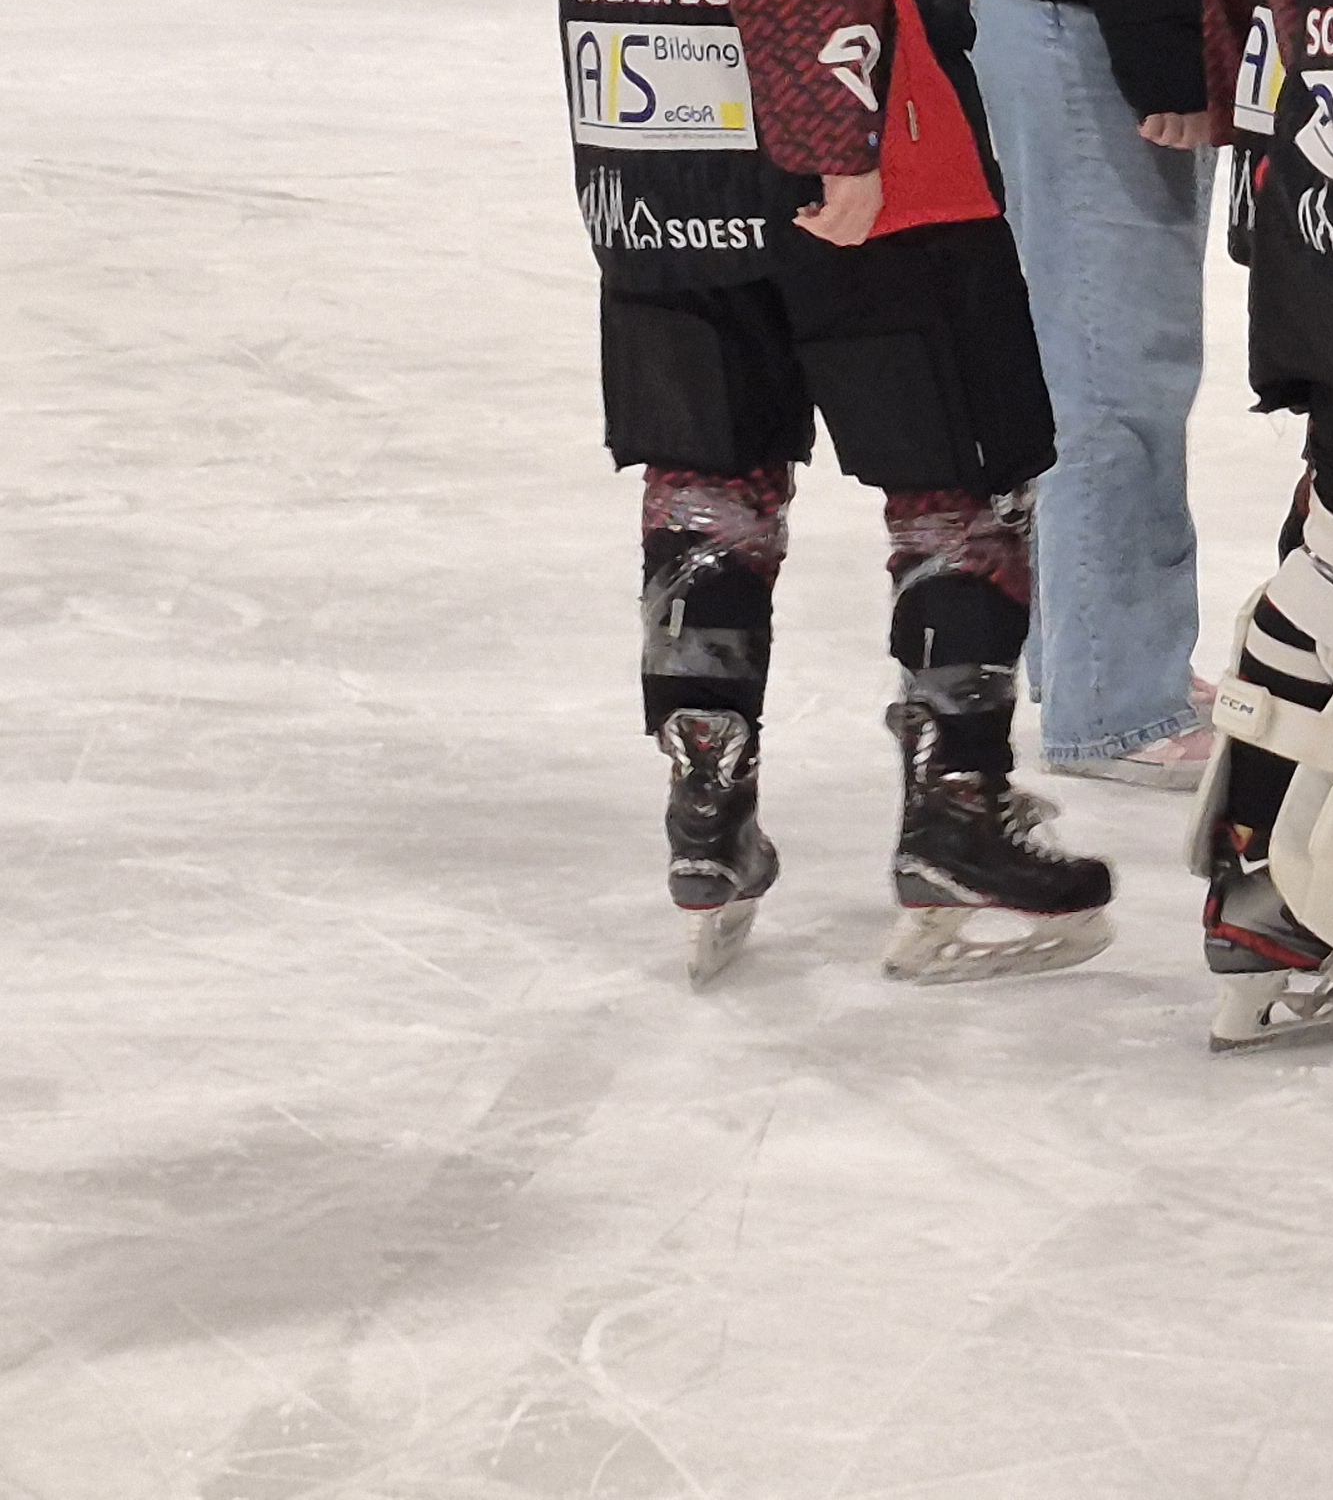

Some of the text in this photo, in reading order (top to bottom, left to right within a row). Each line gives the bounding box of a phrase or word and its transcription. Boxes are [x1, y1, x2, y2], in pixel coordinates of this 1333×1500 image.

[654, 36, 741, 68] Bildung
[667, 217, 767, 251] SOEST
[1220, 694, 1256, 717] CCM
